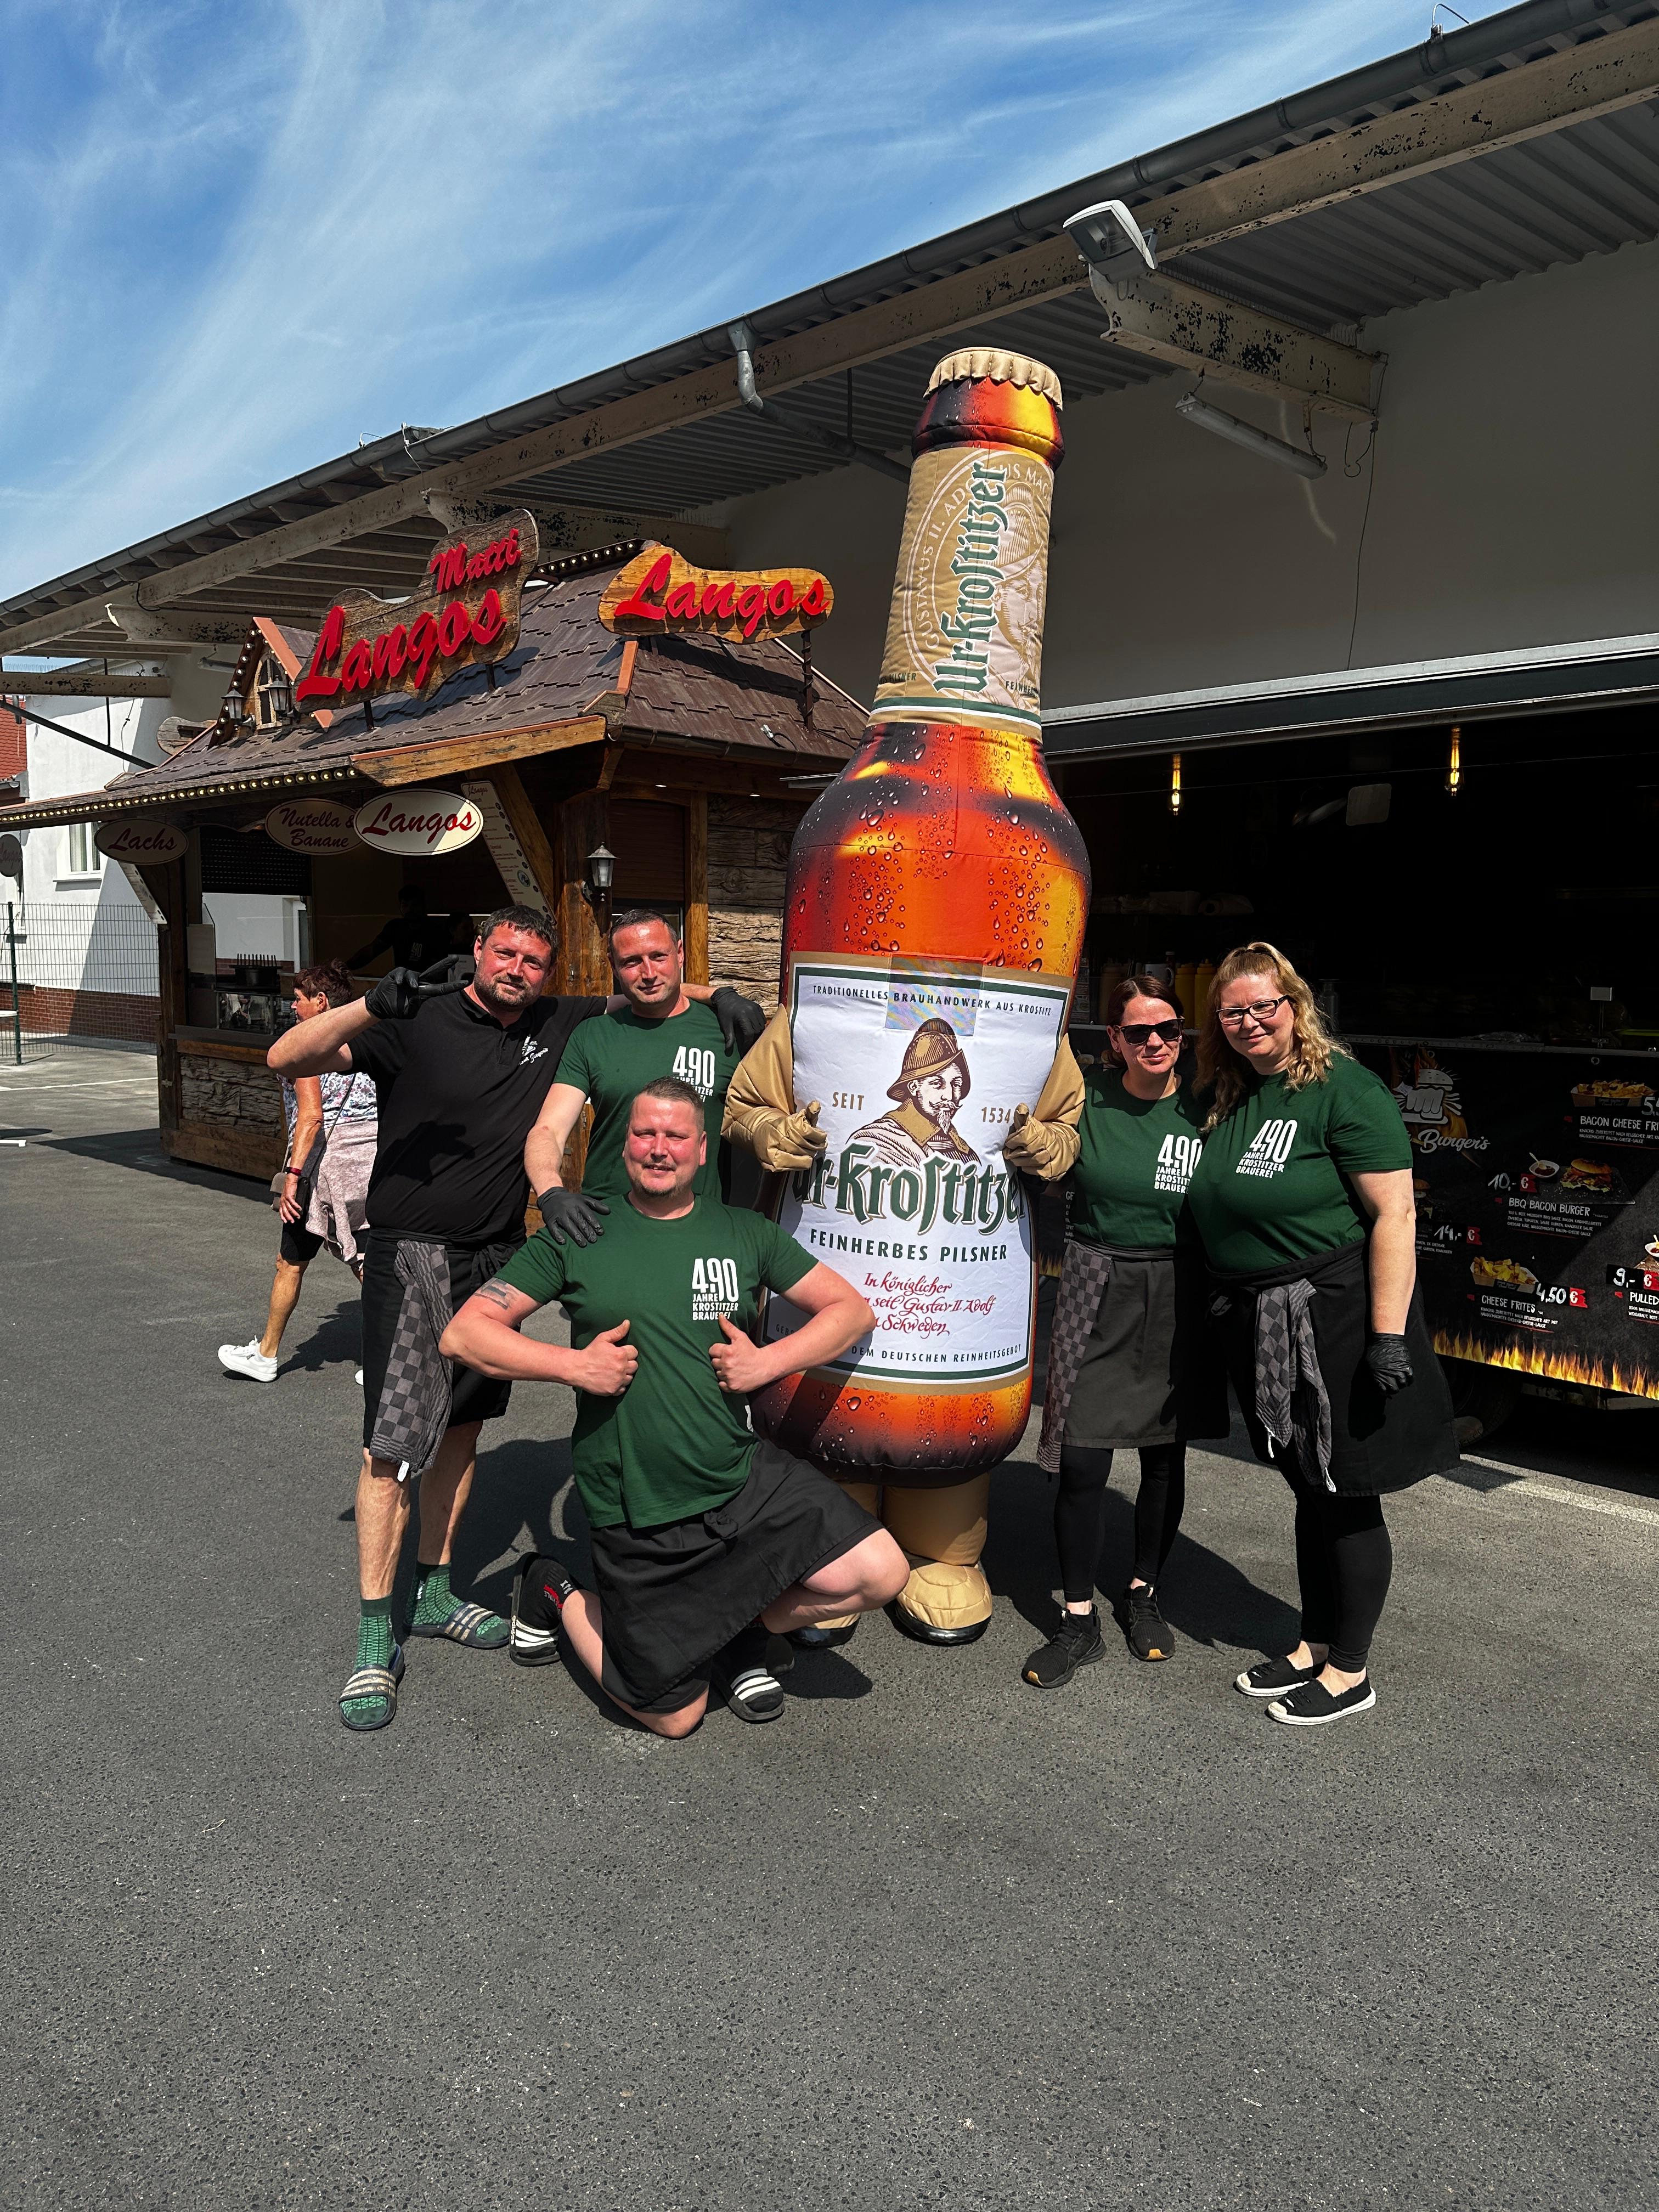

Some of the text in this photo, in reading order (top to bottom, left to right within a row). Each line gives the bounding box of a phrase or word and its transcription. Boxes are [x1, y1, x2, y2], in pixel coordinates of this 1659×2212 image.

[430, 528, 522, 593] Matti
[614, 553, 830, 637] Langos
[296, 589, 508, 702] Langos
[279, 808, 355, 828] Nutella &
[362, 802, 476, 844] Langos
[107, 827, 177, 852] Lachs
[290, 828, 349, 848] Banane
[813, 985, 1051, 1016] TRADITIONELLES BRAUHANDWERK AUS KROSTITZ
[672, 1046, 715, 1088] 490
[832, 1091, 1011, 1124] SEIT 1534
[1581, 1115, 1610, 1126] BACON
[1612, 1118, 1642, 1130] CHEESE
[1249, 1119, 1298, 1163] 490
[1157, 1133, 1203, 1178] 490
[1238, 1158, 1284, 1173] KROSTITZER
[1243, 1151, 1265, 1160] JAHRE
[1156, 1166, 1181, 1176] JAHRE
[1235, 1165, 1274, 1178] BRAUEREI
[1520, 1177, 1529, 1189] €
[1509, 1197, 1527, 1209] BBQ
[1529, 1200, 1556, 1212] BACON
[1559, 1204, 1590, 1217] BURGER
[810, 1228, 1007, 1262] FEINHERBES PILSNER
[692, 1257, 739, 1302] 490
[863, 1271, 952, 1297] In königlicher
[1643, 1274, 1652, 1287] €
[692, 1293, 718, 1302] JAHRE
[1481, 1295, 1508, 1308] CHEESE
[1511, 1300, 1536, 1313] FRITES
[1536, 1283, 1567, 1305] 4,50
[1570, 1291, 1578, 1304] €
[692, 1302, 739, 1312] KROSTITZER
[872, 1295, 905, 1310] seit
[899, 1296, 953, 1318] Gustav
[962, 1294, 997, 1316] Adolf
[882, 1313, 950, 1339] Schweden
[851, 1343, 1022, 1363] DEM DEUTSCHEN REINHEITSGEBOT
